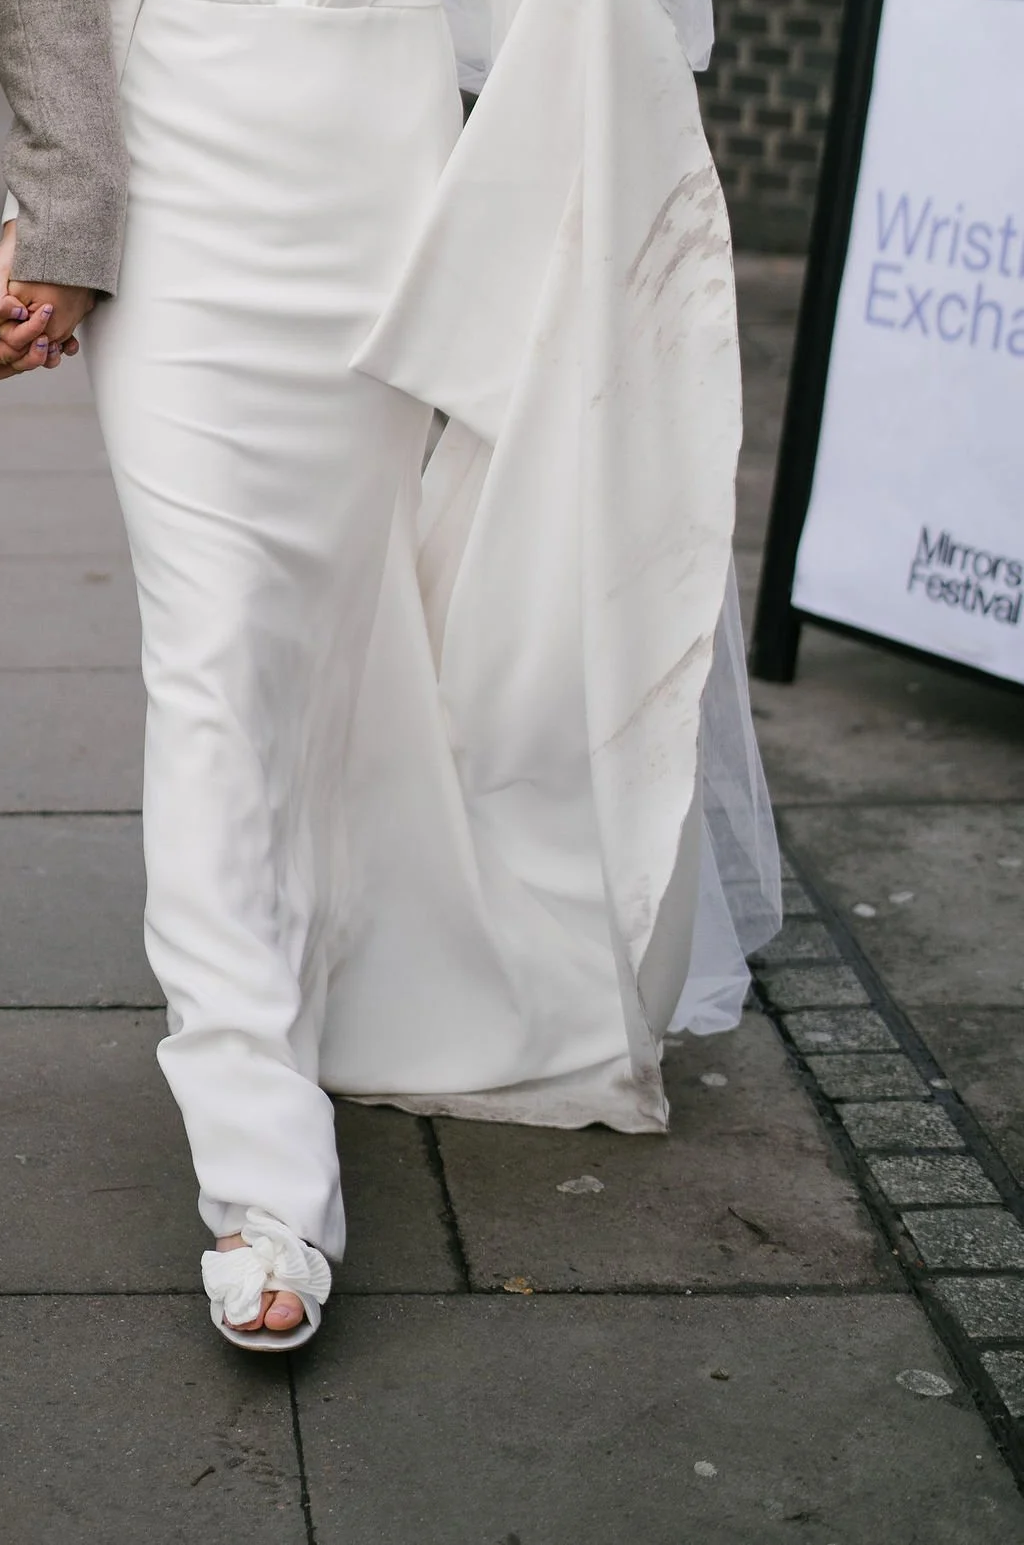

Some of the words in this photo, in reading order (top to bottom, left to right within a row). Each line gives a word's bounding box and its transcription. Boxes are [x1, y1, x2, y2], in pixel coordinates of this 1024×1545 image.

[877, 189, 1024, 279] Wrist
[915, 525, 1024, 588] Mirrors
[906, 559, 1024, 626] Festival
